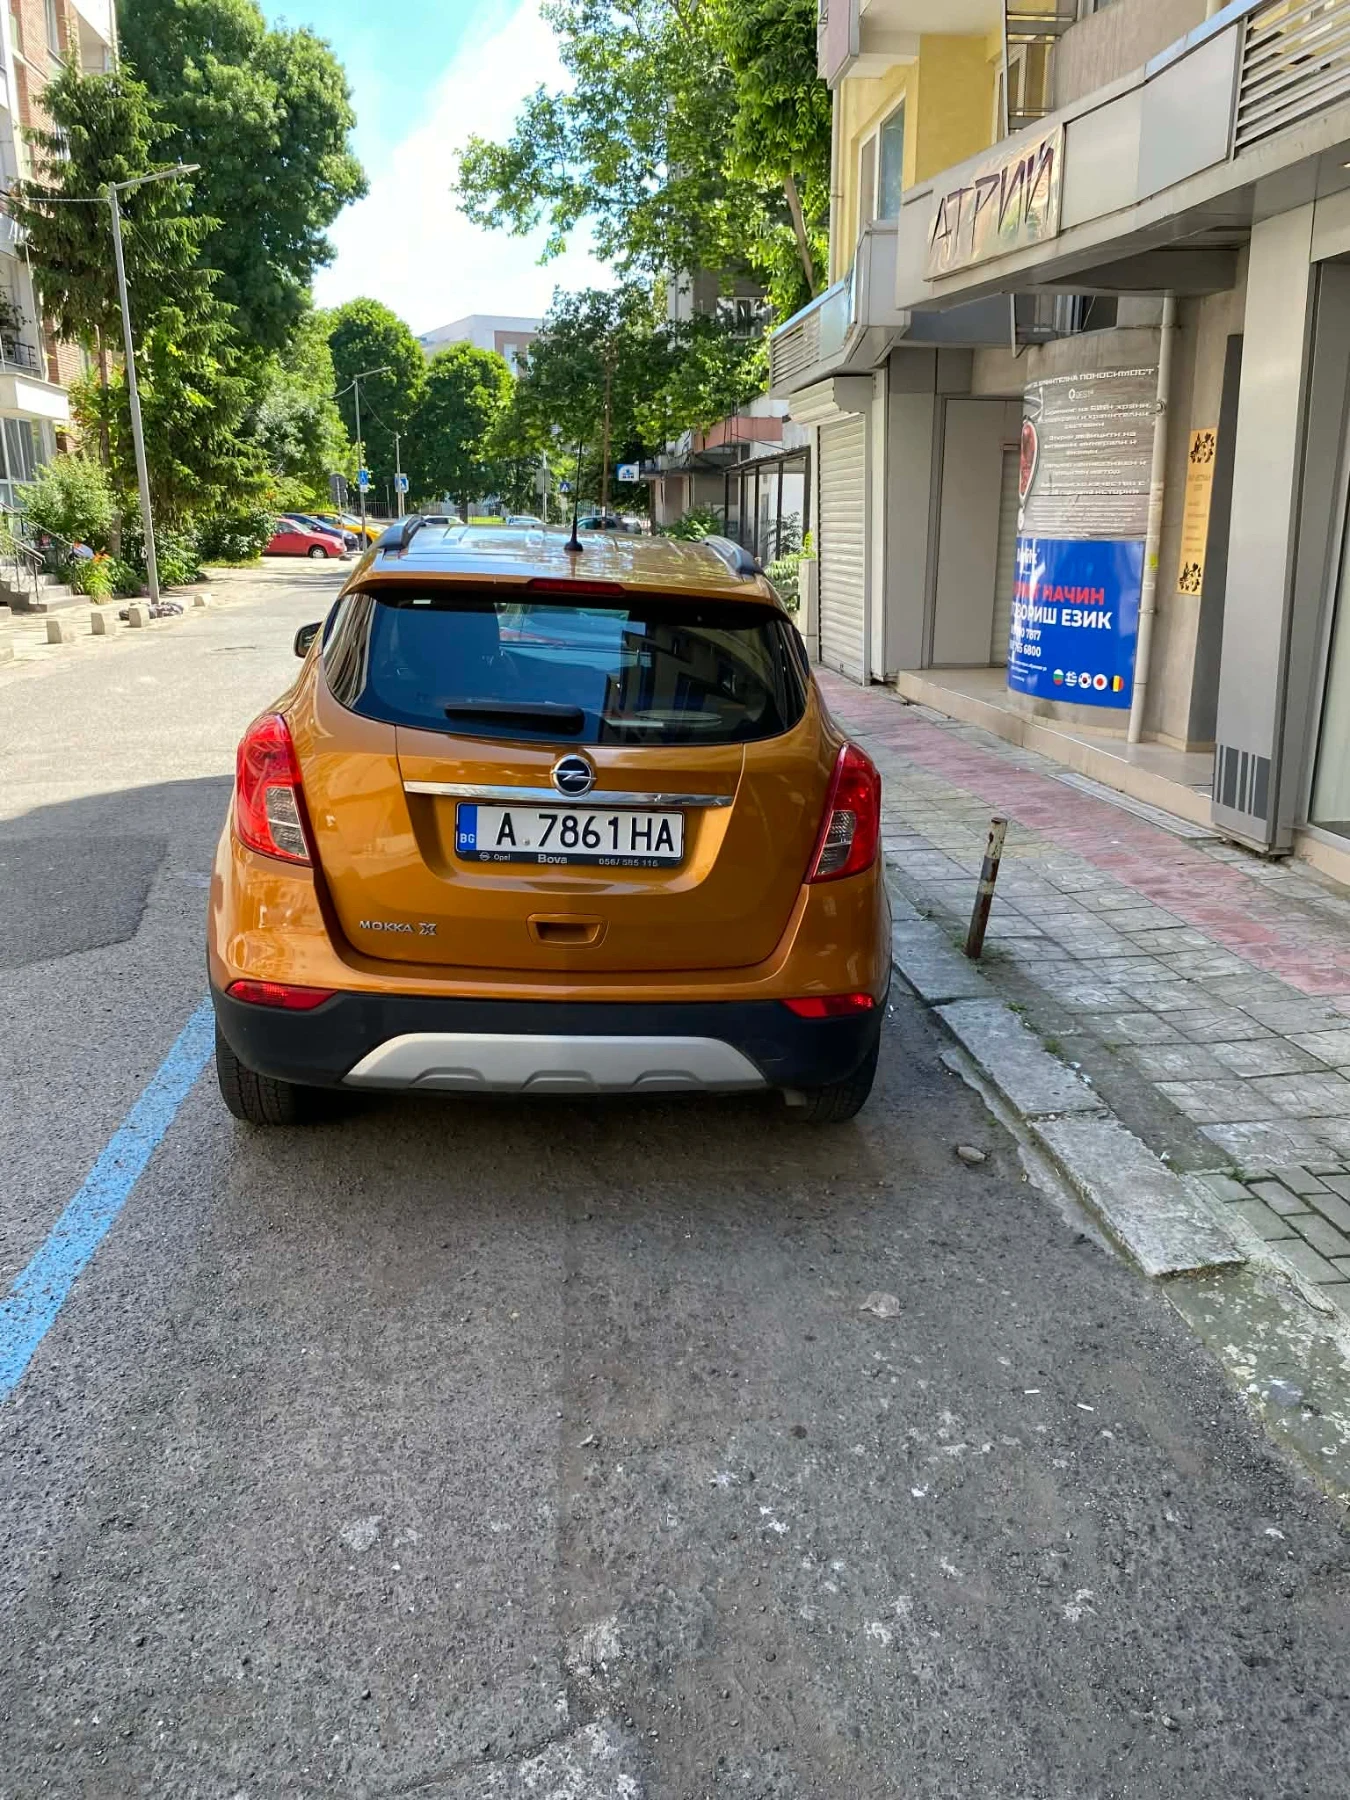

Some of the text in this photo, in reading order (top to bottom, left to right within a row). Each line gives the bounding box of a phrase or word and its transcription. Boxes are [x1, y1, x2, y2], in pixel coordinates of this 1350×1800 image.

[1043, 585, 1105, 605] НАЧИН
[1061, 608, 1113, 629] ЕЗИК
[496, 812, 517, 846] A
[460, 833, 475, 844] BG
[537, 853, 568, 864] Bova
[360, 920, 437, 936] MOKKA X
